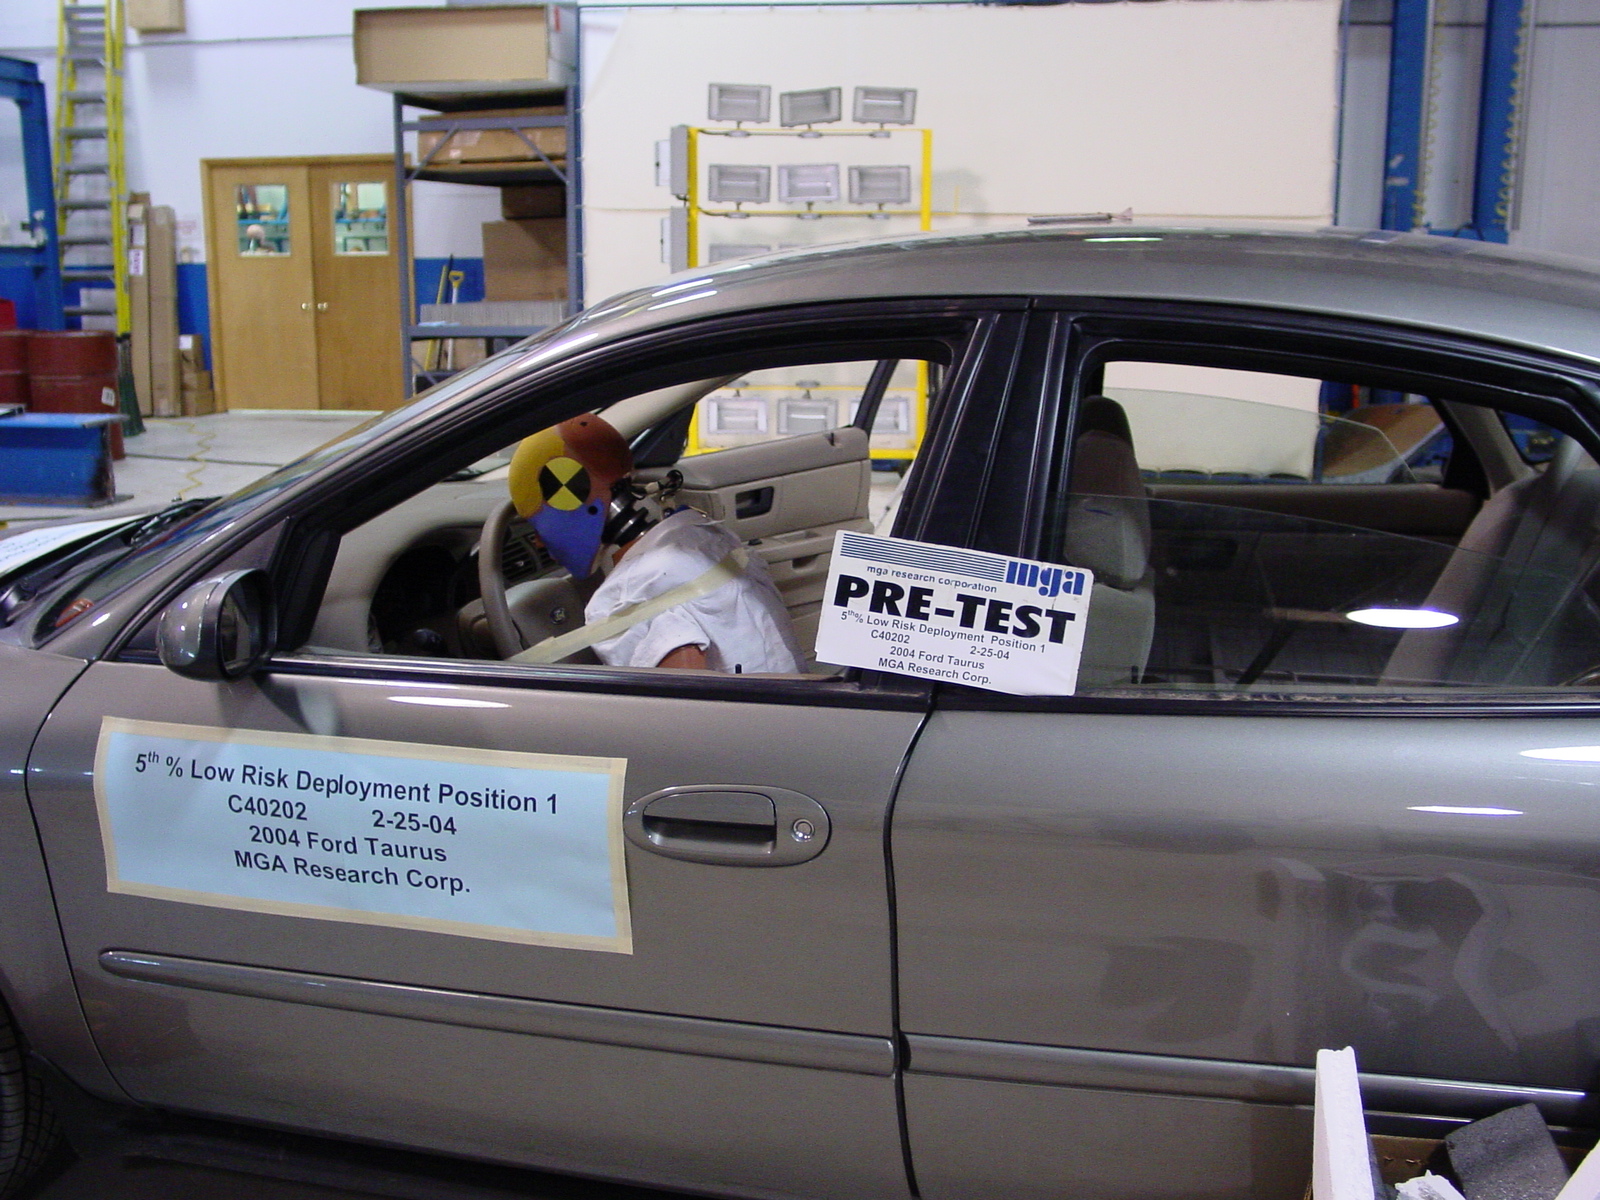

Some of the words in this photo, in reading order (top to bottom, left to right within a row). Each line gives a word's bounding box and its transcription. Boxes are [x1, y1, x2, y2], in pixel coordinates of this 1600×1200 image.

[866, 565, 888, 576] mga
[891, 569, 935, 583] research
[938, 576, 997, 594] corporation
[1006, 561, 1085, 597] mga
[833, 574, 1076, 645] PRE-TEST
[866, 615, 890, 628] Low
[891, 619, 916, 632] Risk
[919, 625, 984, 644] Deployment
[990, 635, 1037, 653] Position
[1038, 644, 1046, 654] 1
[870, 629, 911, 645] C40202
[969, 645, 1010, 661] 2-25-04
[878, 657, 905, 672] MGA
[907, 662, 960, 679] Research
[961, 671, 993, 686] Corp.
[889, 645, 916, 659] 2004
[918, 651, 945, 664] Ford
[947, 655, 986, 670] Taurus
[166, 756, 184, 778] %
[191, 759, 236, 783] Low
[241, 764, 290, 789] Risk
[296, 770, 431, 803] Deployment
[438, 783, 538, 813] Position
[547, 793, 557, 815] 1
[228, 794, 308, 821] C40202
[372, 809, 458, 835] 2-25-04
[249, 825, 301, 848] 2004
[307, 831, 358, 855] Ford
[364, 838, 448, 862] Taurus
[234, 850, 288, 874] MGA
[293, 857, 400, 886] Research
[406, 869, 471, 896] Corp.
